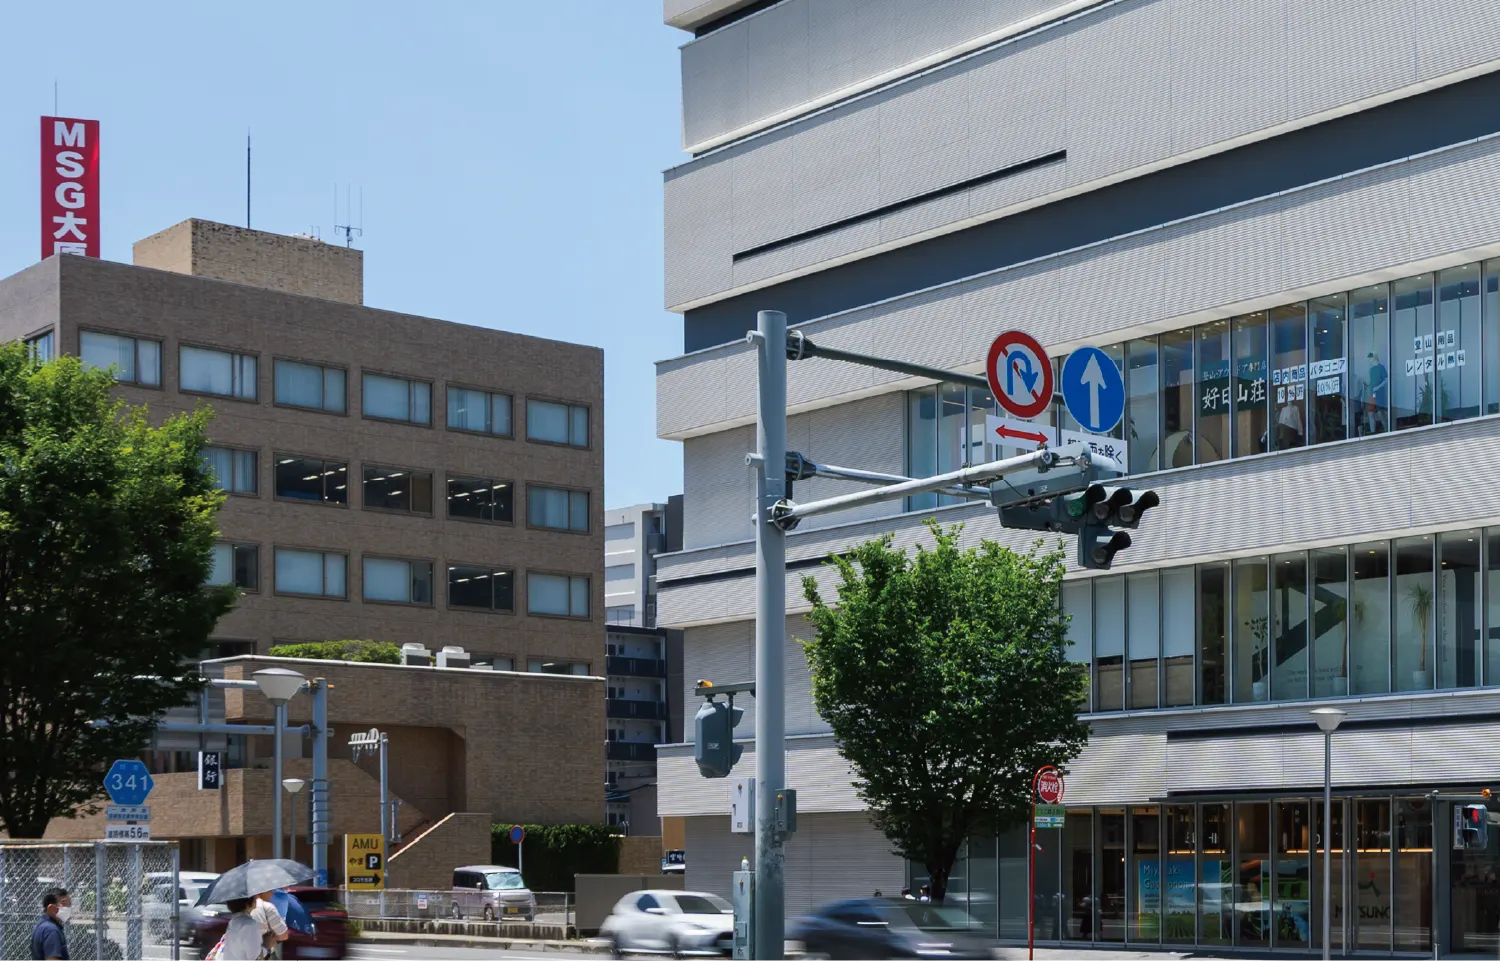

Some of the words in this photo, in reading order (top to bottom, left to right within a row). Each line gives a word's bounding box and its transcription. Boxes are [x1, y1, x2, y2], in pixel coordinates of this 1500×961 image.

[1415, 334, 1454, 348] 登山用品
[1311, 359, 1346, 375] パタゴニア
[1406, 355, 1465, 372] レンタル無料
[204, 754, 218, 783] 銀行
[112, 773, 148, 791] 341
[1040, 780, 1059, 794] 消火栓
[352, 838, 379, 850] AMU
